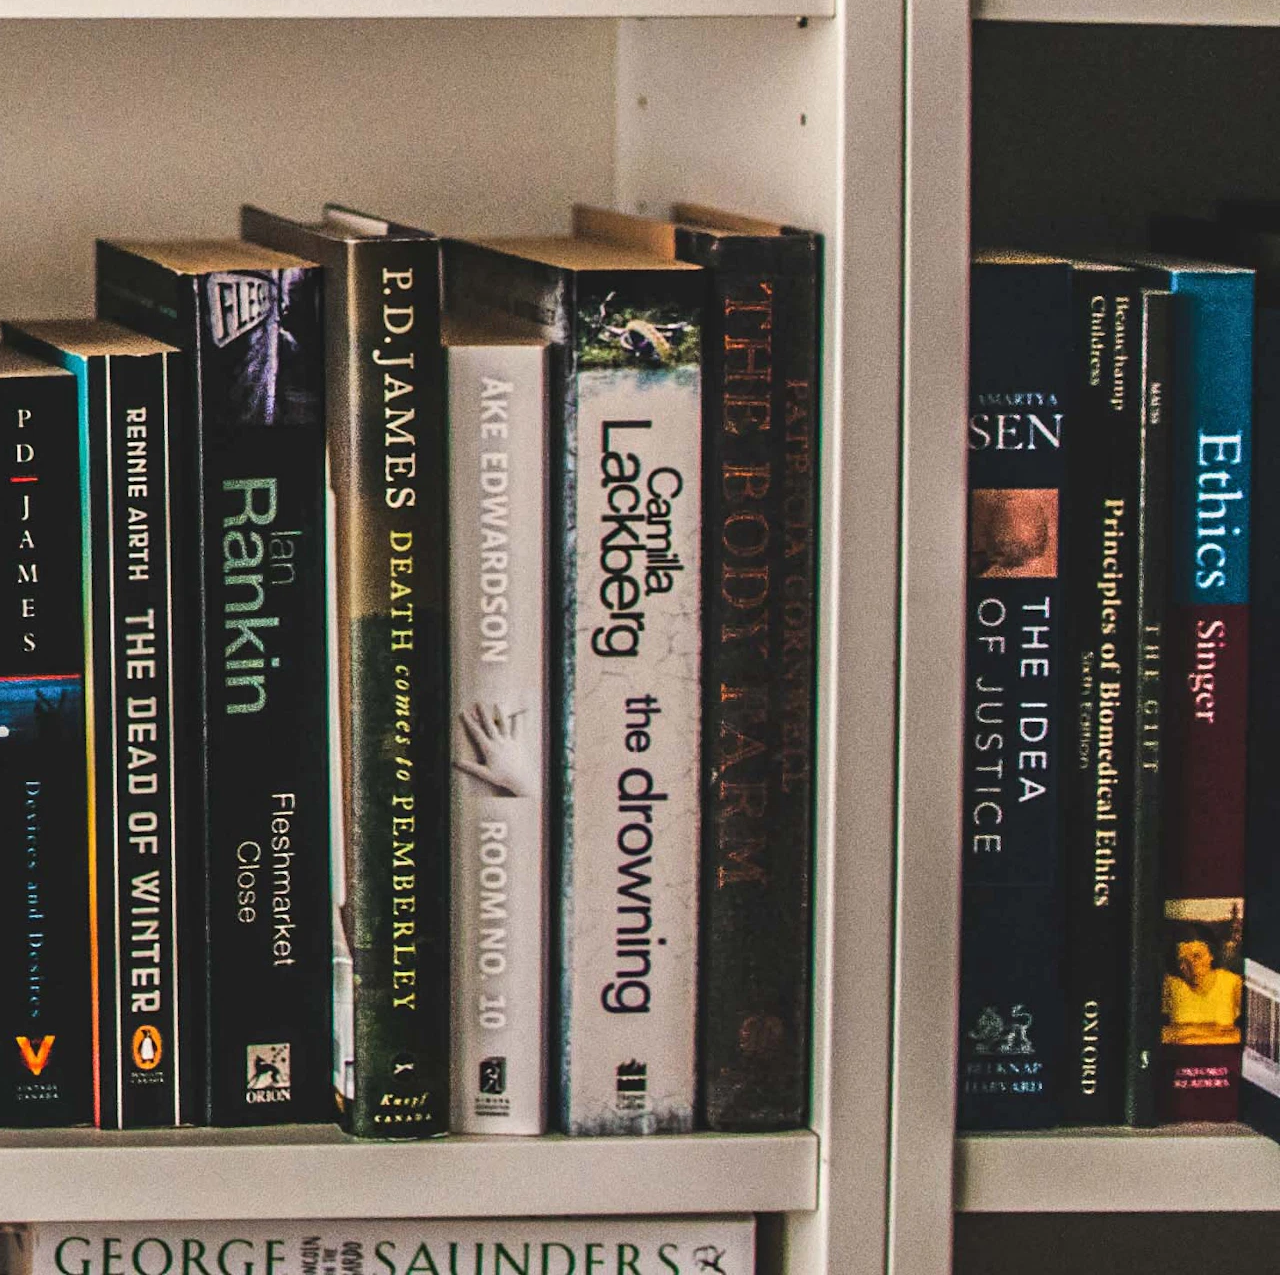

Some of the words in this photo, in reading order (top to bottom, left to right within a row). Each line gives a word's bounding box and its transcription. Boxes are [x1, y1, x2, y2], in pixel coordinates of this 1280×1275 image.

[1194, 432, 1244, 590] Ethics
[974, 597, 1006, 655] OF
[1018, 596, 1051, 677] THE
[1190, 620, 1226, 724] Singer
[972, 676, 1004, 854] JUSTICE
[1017, 701, 1048, 803] IDEA
[236, 840, 264, 924] Close
[267, 792, 297, 965] Fleshmarket
[245, 1091, 292, 1103] ORION
